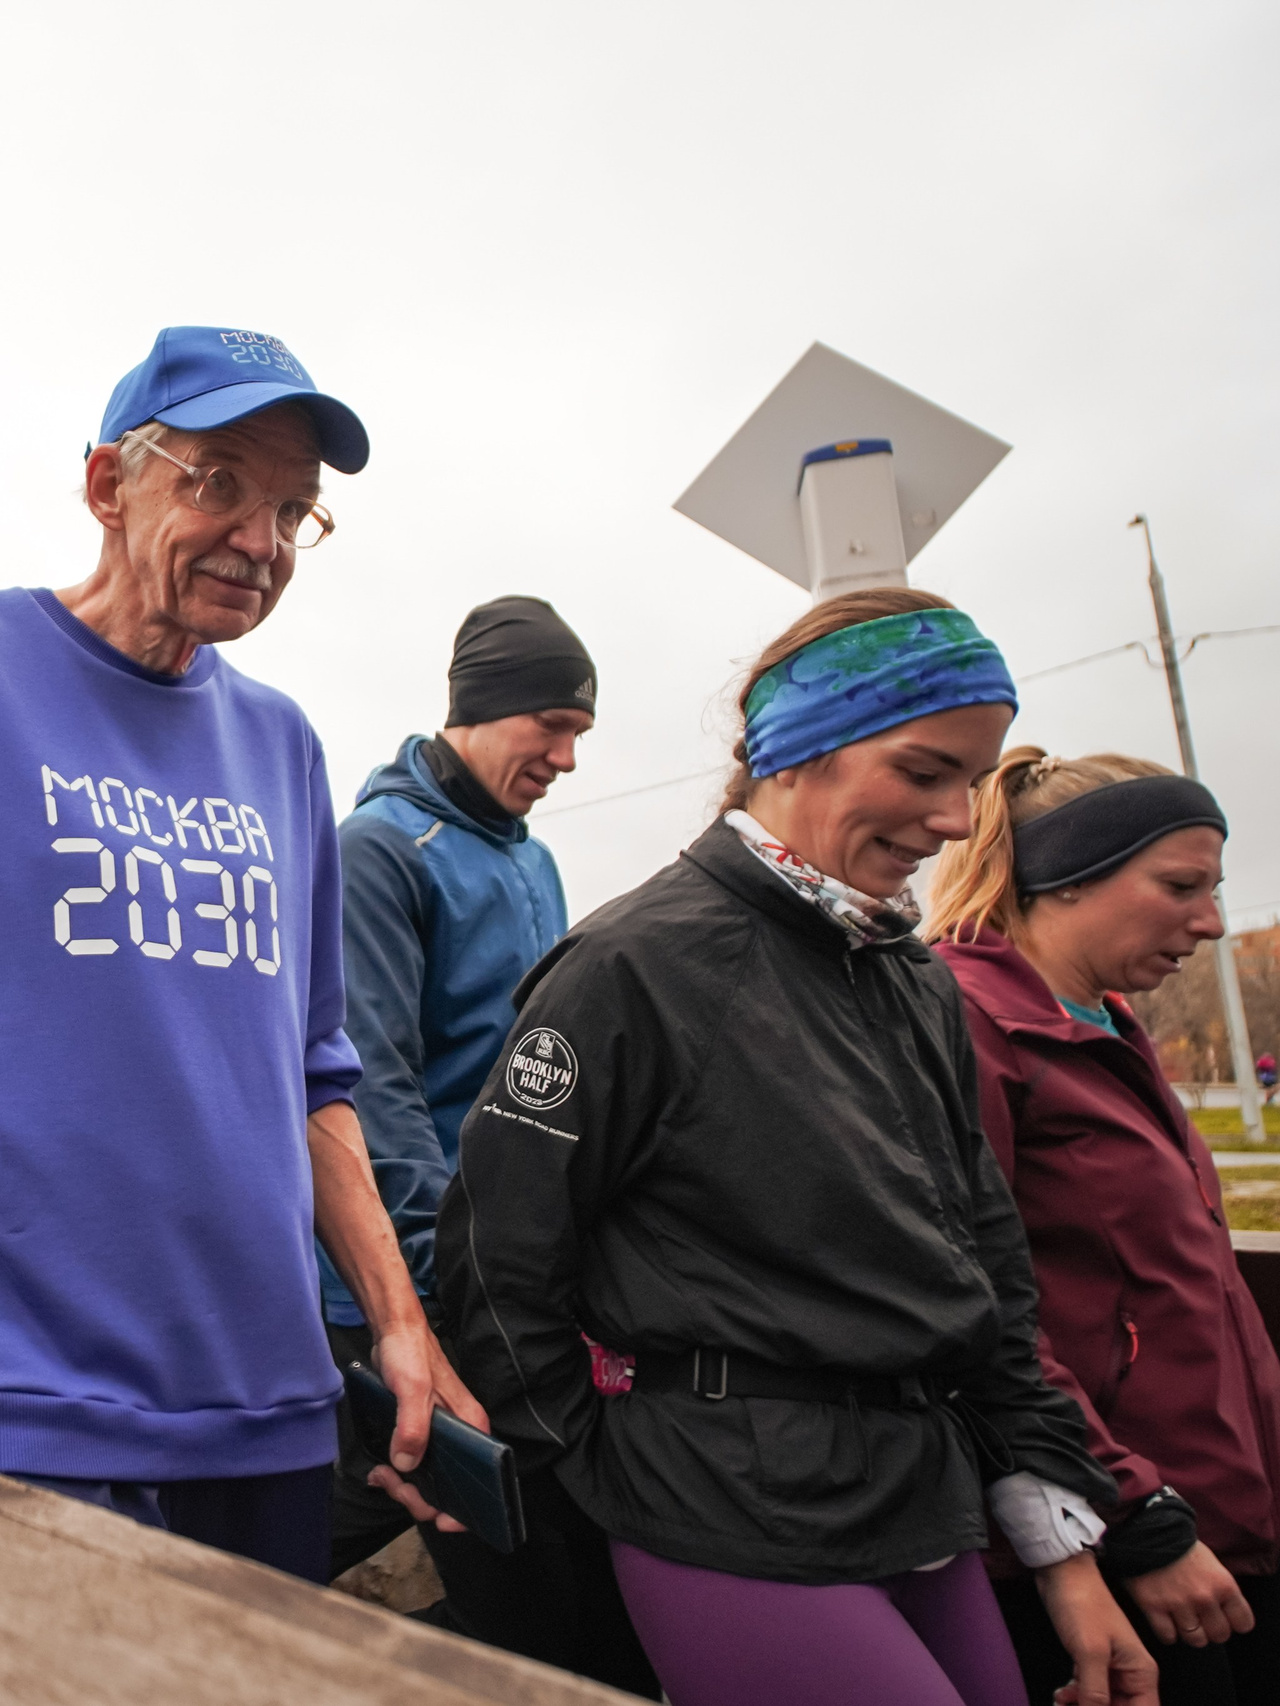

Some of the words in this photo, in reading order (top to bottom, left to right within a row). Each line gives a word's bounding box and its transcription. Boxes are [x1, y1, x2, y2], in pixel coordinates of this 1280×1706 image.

[227, 344, 303, 380] 2030
[41, 764, 274, 861] МОСКВА
[51, 837, 281, 976] 2030
[512, 1053, 572, 1085] BROOKLYN
[520, 1071, 552, 1093] HALF
[519, 1115, 535, 1125] YORK
